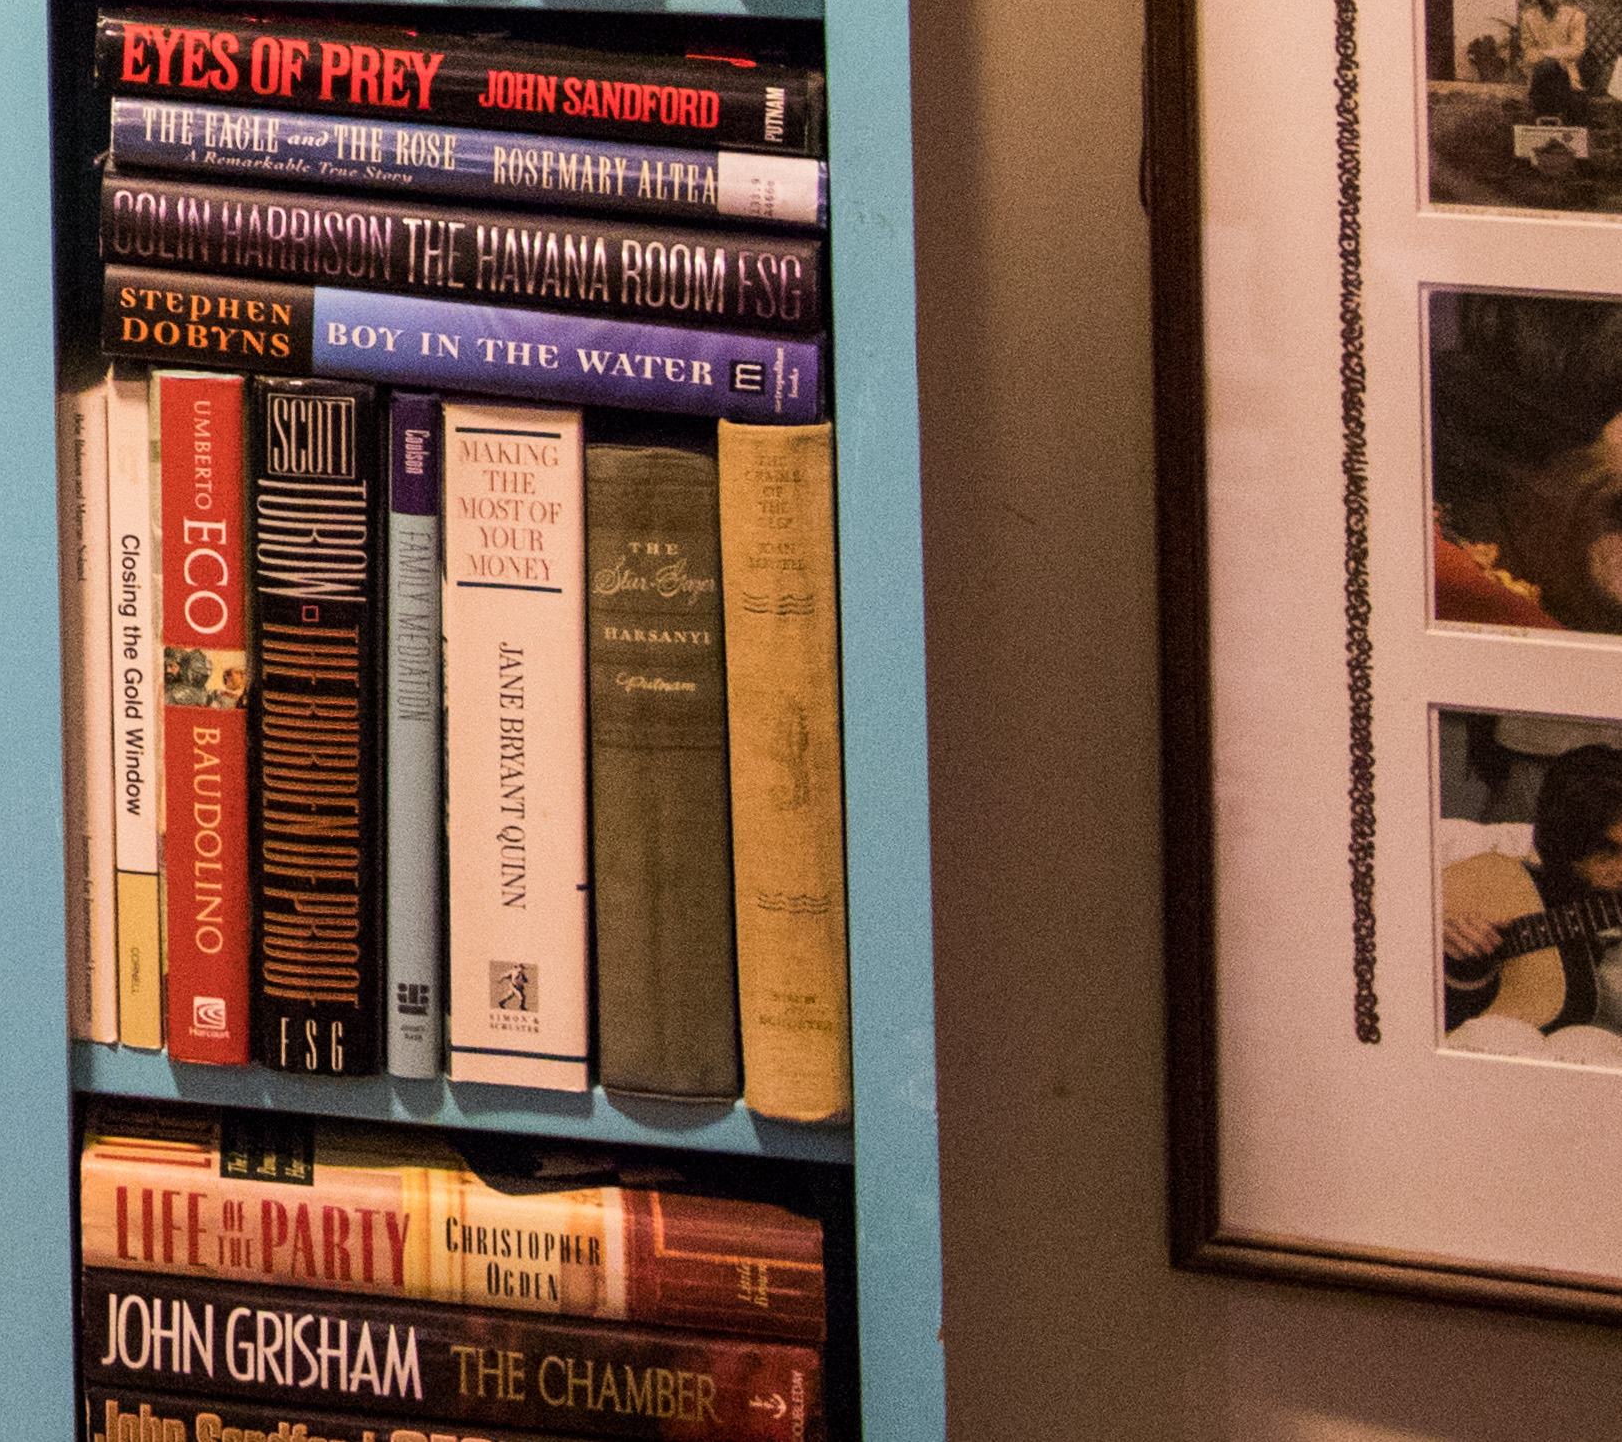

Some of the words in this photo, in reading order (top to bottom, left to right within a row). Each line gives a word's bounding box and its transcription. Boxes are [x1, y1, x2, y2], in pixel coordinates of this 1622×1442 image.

[120, 23, 239, 91] EYES
[251, 36, 310, 96] OF
[319, 43, 445, 110] PREY
[479, 69, 557, 112] JOHN
[563, 77, 720, 129] SANDFORD
[120, 288, 291, 326] STEPHEN
[122, 317, 290, 358] DOBYNS
[327, 322, 403, 352] BOY
[420, 330, 460, 360] IN
[477, 339, 559, 369] THE
[577, 349, 713, 386] WATER
[193, 401, 213, 510] UMBERTO
[118, 535, 141, 618] Closing
[183, 517, 228, 635] ECO
[123, 625, 143, 660] the
[498, 642, 524, 709] JANE
[124, 669, 144, 719] Gold
[124, 726, 145, 816] Window
[499, 717, 526, 820] BRYANT
[193, 726, 224, 954] BAUDOLINO
[497, 825, 526, 911] QUINN
[113, 1186, 210, 1268] LIFE
[217, 1234, 255, 1269] THE
[222, 1198, 247, 1232] OF
[260, 1199, 412, 1292] PARTY
[444, 1216, 602, 1268] CHRISTOPHER
[485, 1260, 560, 1304] OGDEN
[100, 1294, 216, 1375] JOHN
[224, 1306, 423, 1403] GRISHAM
[450, 1344, 527, 1402] THE
[538, 1354, 720, 1424] CHAMBER
